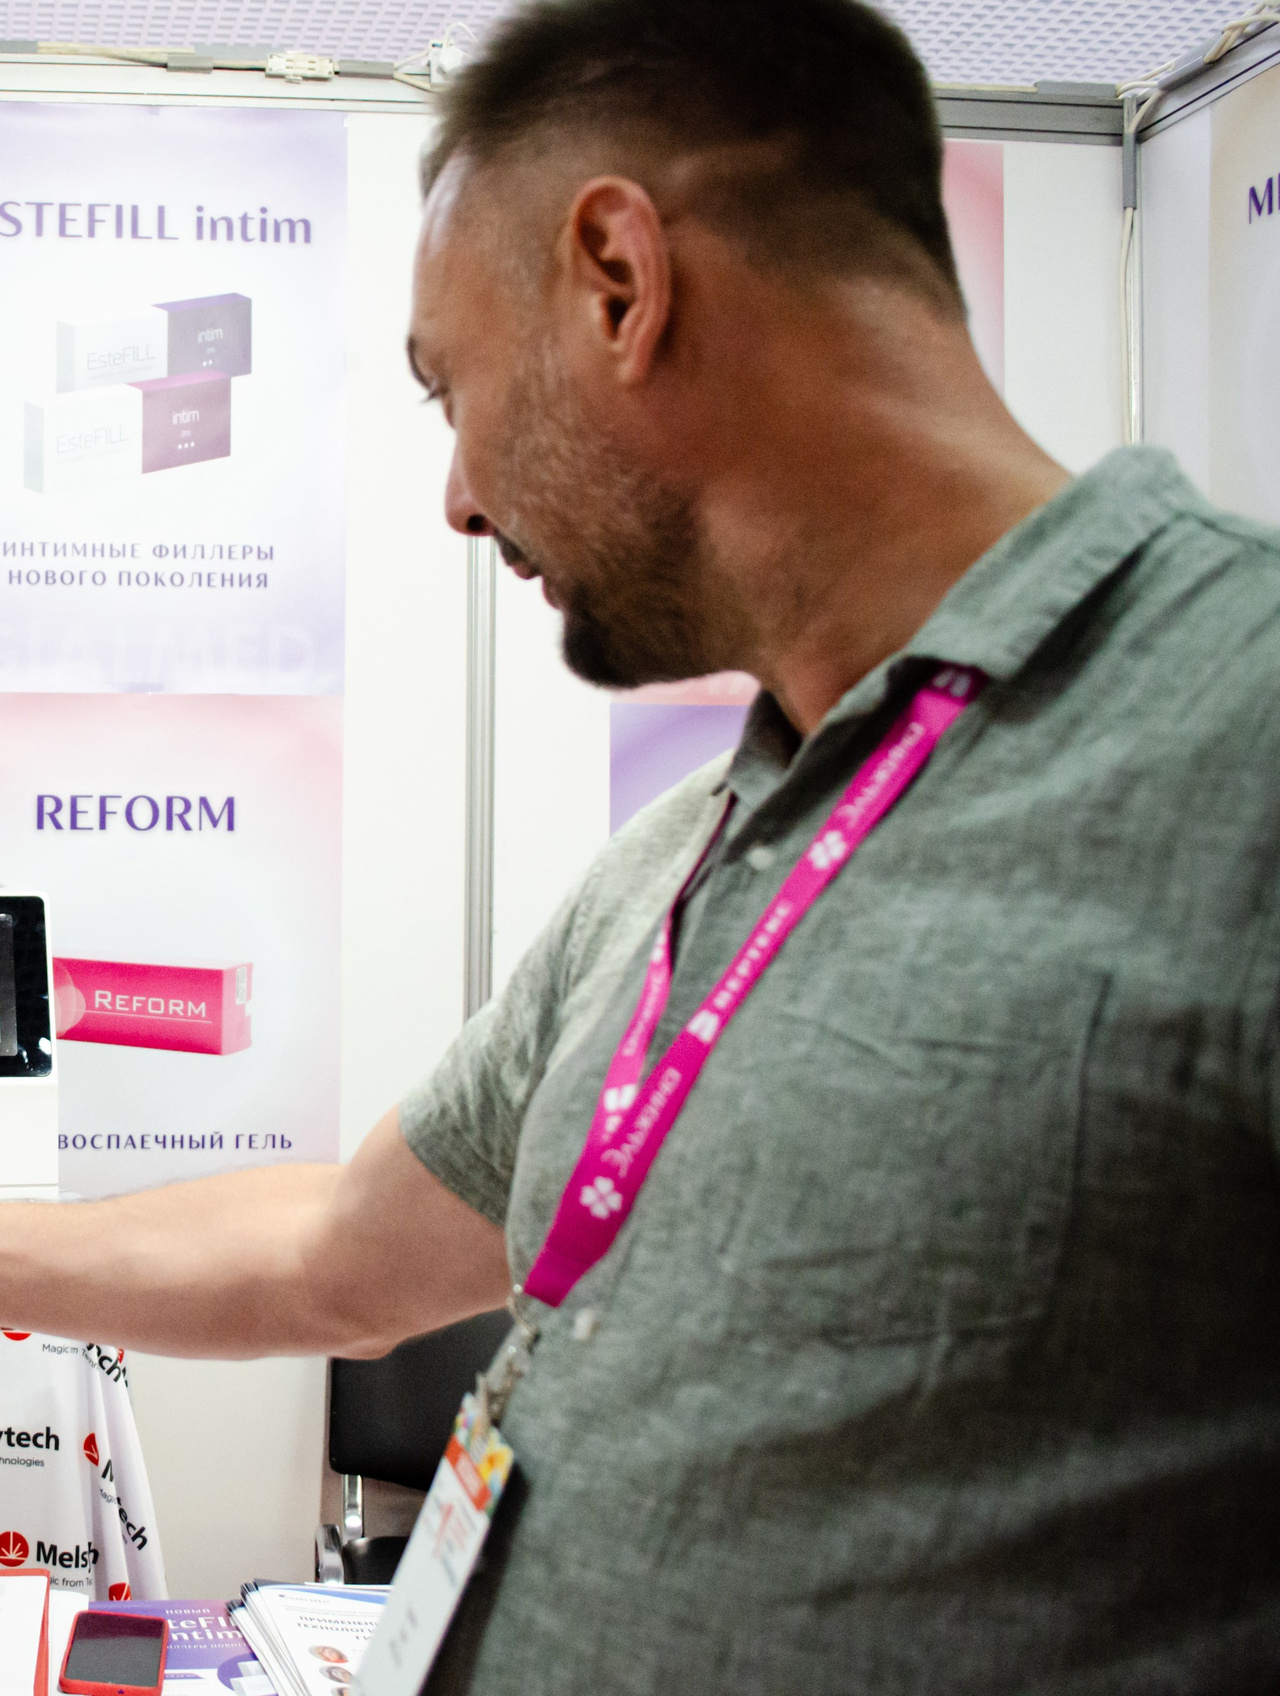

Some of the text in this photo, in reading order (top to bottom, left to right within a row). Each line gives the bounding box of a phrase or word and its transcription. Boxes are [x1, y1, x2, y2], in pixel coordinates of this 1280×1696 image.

[195, 204, 312, 244] intim
[197, 327, 223, 343] intim
[86, 343, 156, 371] EsteFILL
[172, 409, 200, 426] intim
[56, 424, 130, 454] EsteFILL
[2, 540, 275, 562] ИНТИМНЫЕ ФИЛЛЕРЫ
[8, 568, 269, 589] НОВОГО ПОКОЛЕНИЯ
[35, 794, 236, 832] REFORM
[94, 989, 207, 1019] REFORM
[58, 1129, 293, 1151] ВОСПАЕЧНЫЙ ГЕЛЬ
[61, 1577, 83, 1587] from
